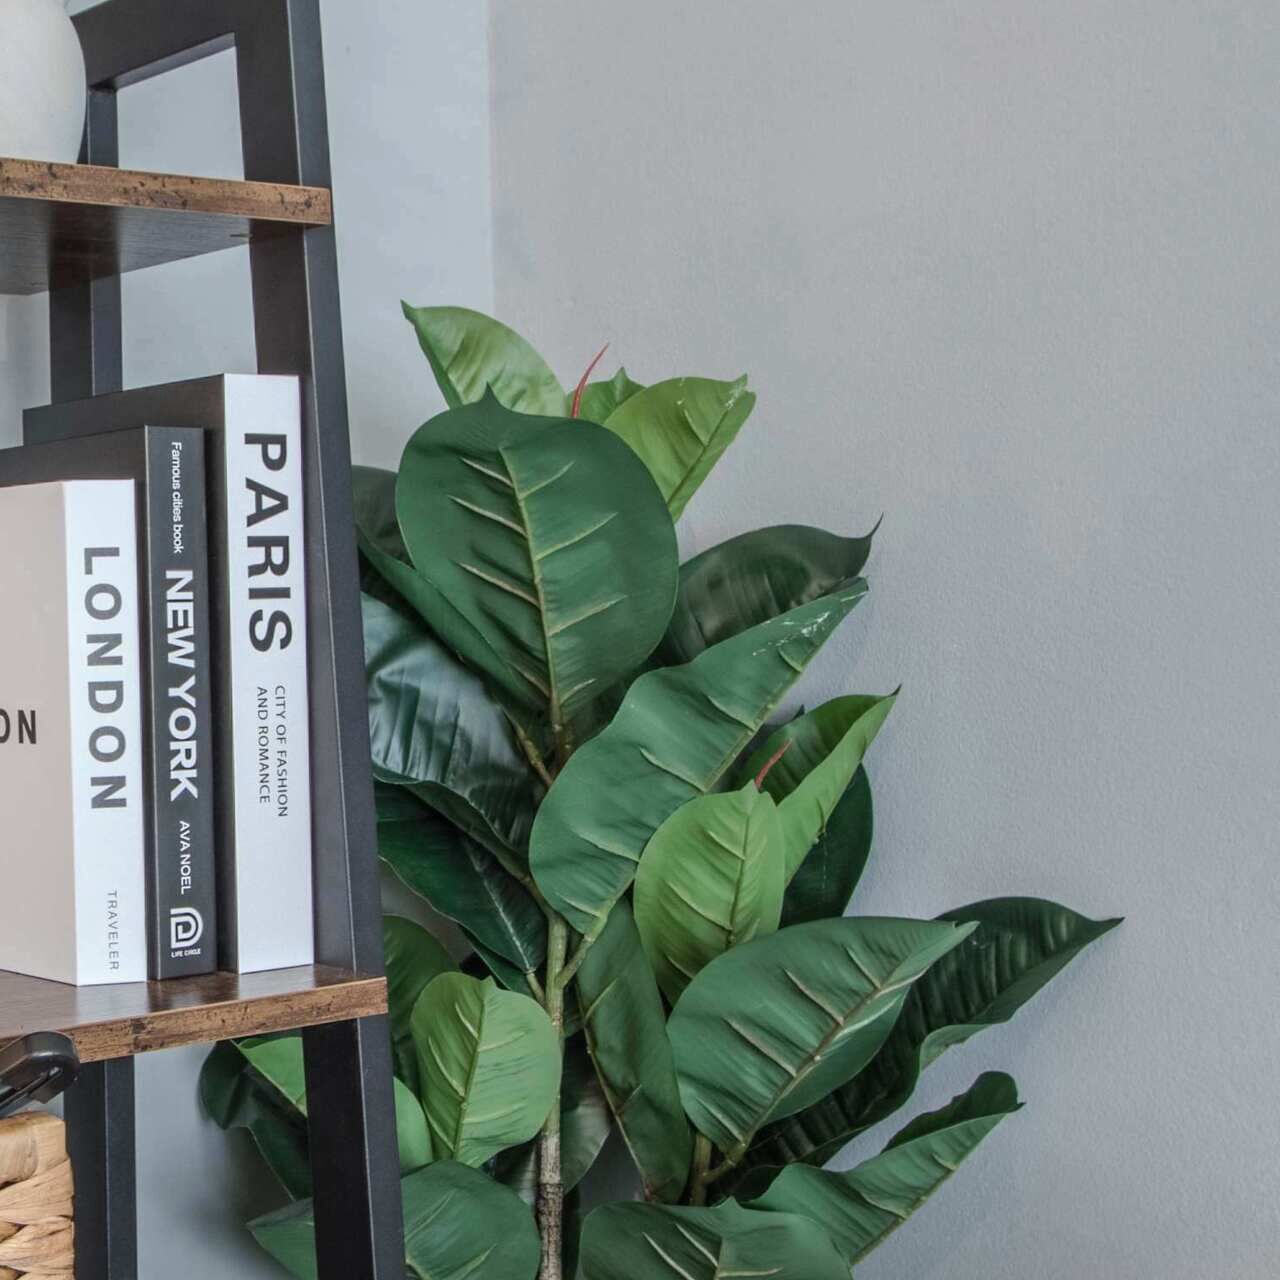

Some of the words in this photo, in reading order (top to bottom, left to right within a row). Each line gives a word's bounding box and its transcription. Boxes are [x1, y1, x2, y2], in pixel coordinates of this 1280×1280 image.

[172, 441, 183, 490] Famous
[172, 491, 184, 522] cities
[173, 524, 185, 554] book
[244, 433, 294, 653] PARIS
[165, 569, 197, 668] NEW
[83, 547, 128, 810] LONDON
[275, 685, 287, 719] CITY
[257, 686, 269, 721] AND
[167, 674, 199, 802] YORK
[275, 724, 287, 745] OF
[258, 726, 271, 804] ROMANCE
[276, 750, 289, 817] FASHION
[179, 820, 191, 852] AVA
[180, 854, 192, 895] NOEL
[107, 889, 120, 971] TRAVELER
